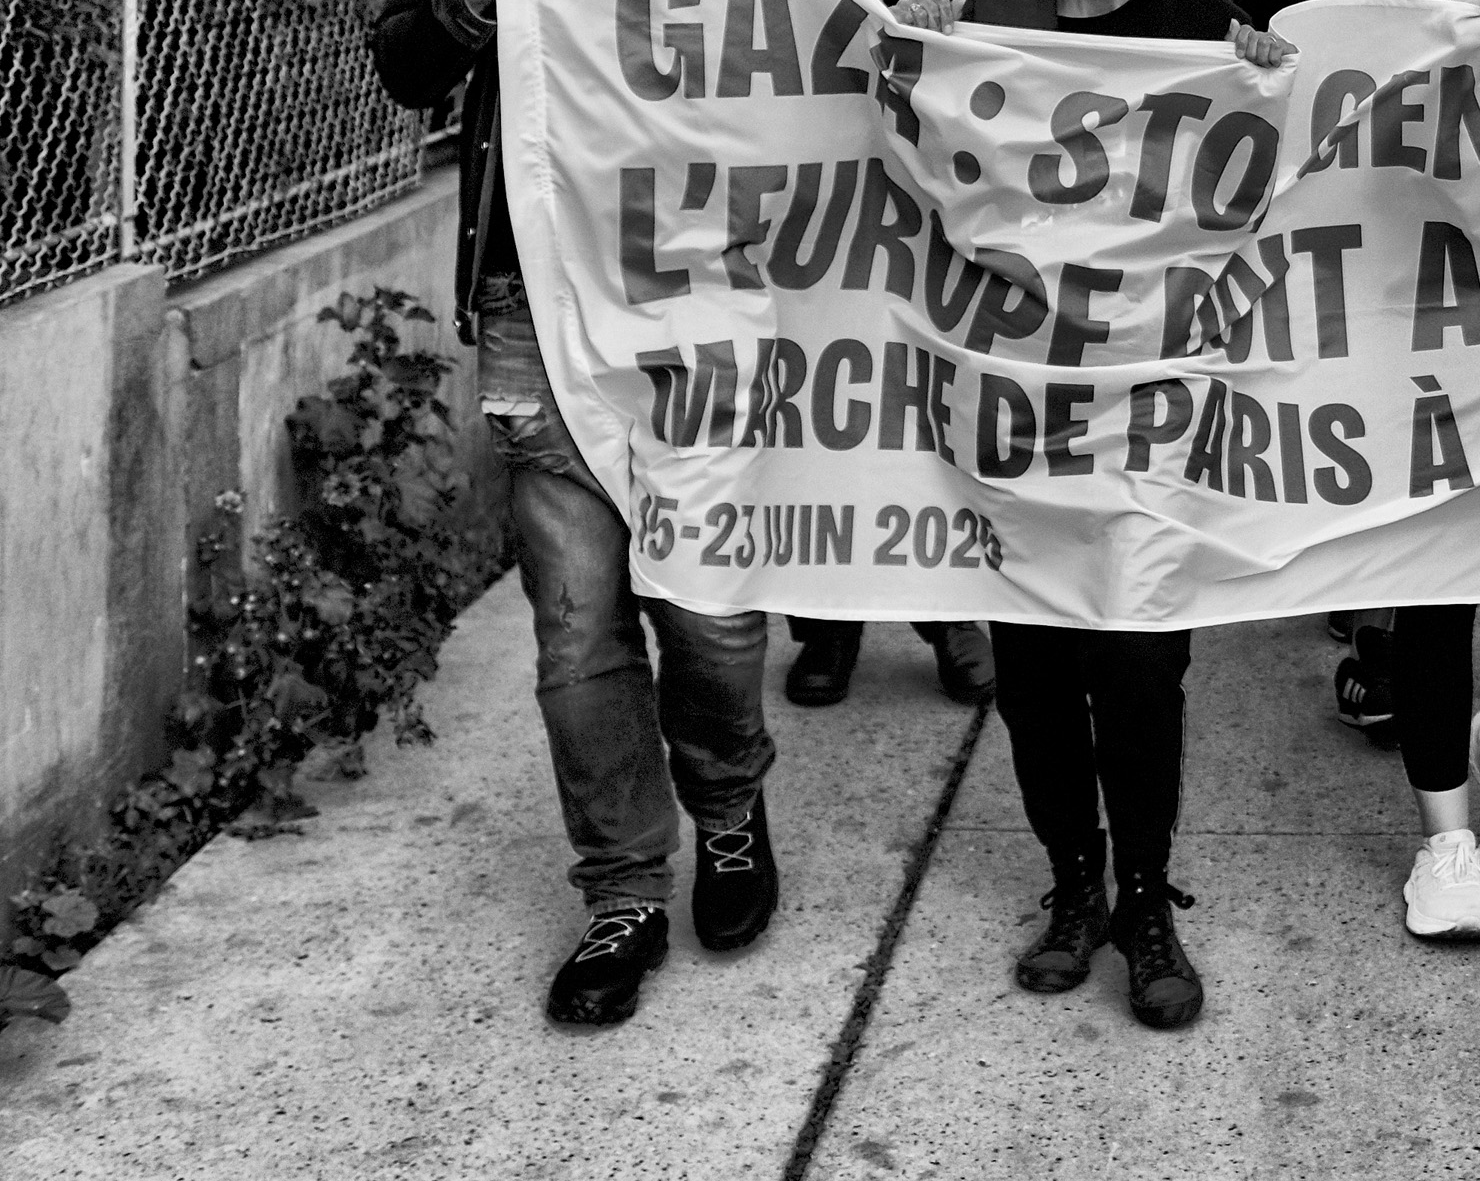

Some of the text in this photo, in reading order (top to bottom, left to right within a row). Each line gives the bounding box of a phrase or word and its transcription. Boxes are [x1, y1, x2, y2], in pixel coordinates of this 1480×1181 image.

[1026, 90, 1278, 234] STO
[618, 156, 1124, 367] L'EUROPE
[1159, 223, 1363, 365] DOIT
[634, 337, 958, 468] MARCHE
[975, 372, 1096, 480] DE
[1125, 376, 1373, 505] PARIS
[1408, 374, 1475, 499] À
[761, 504, 855, 568] JUIN
[872, 503, 1004, 572] 2025
